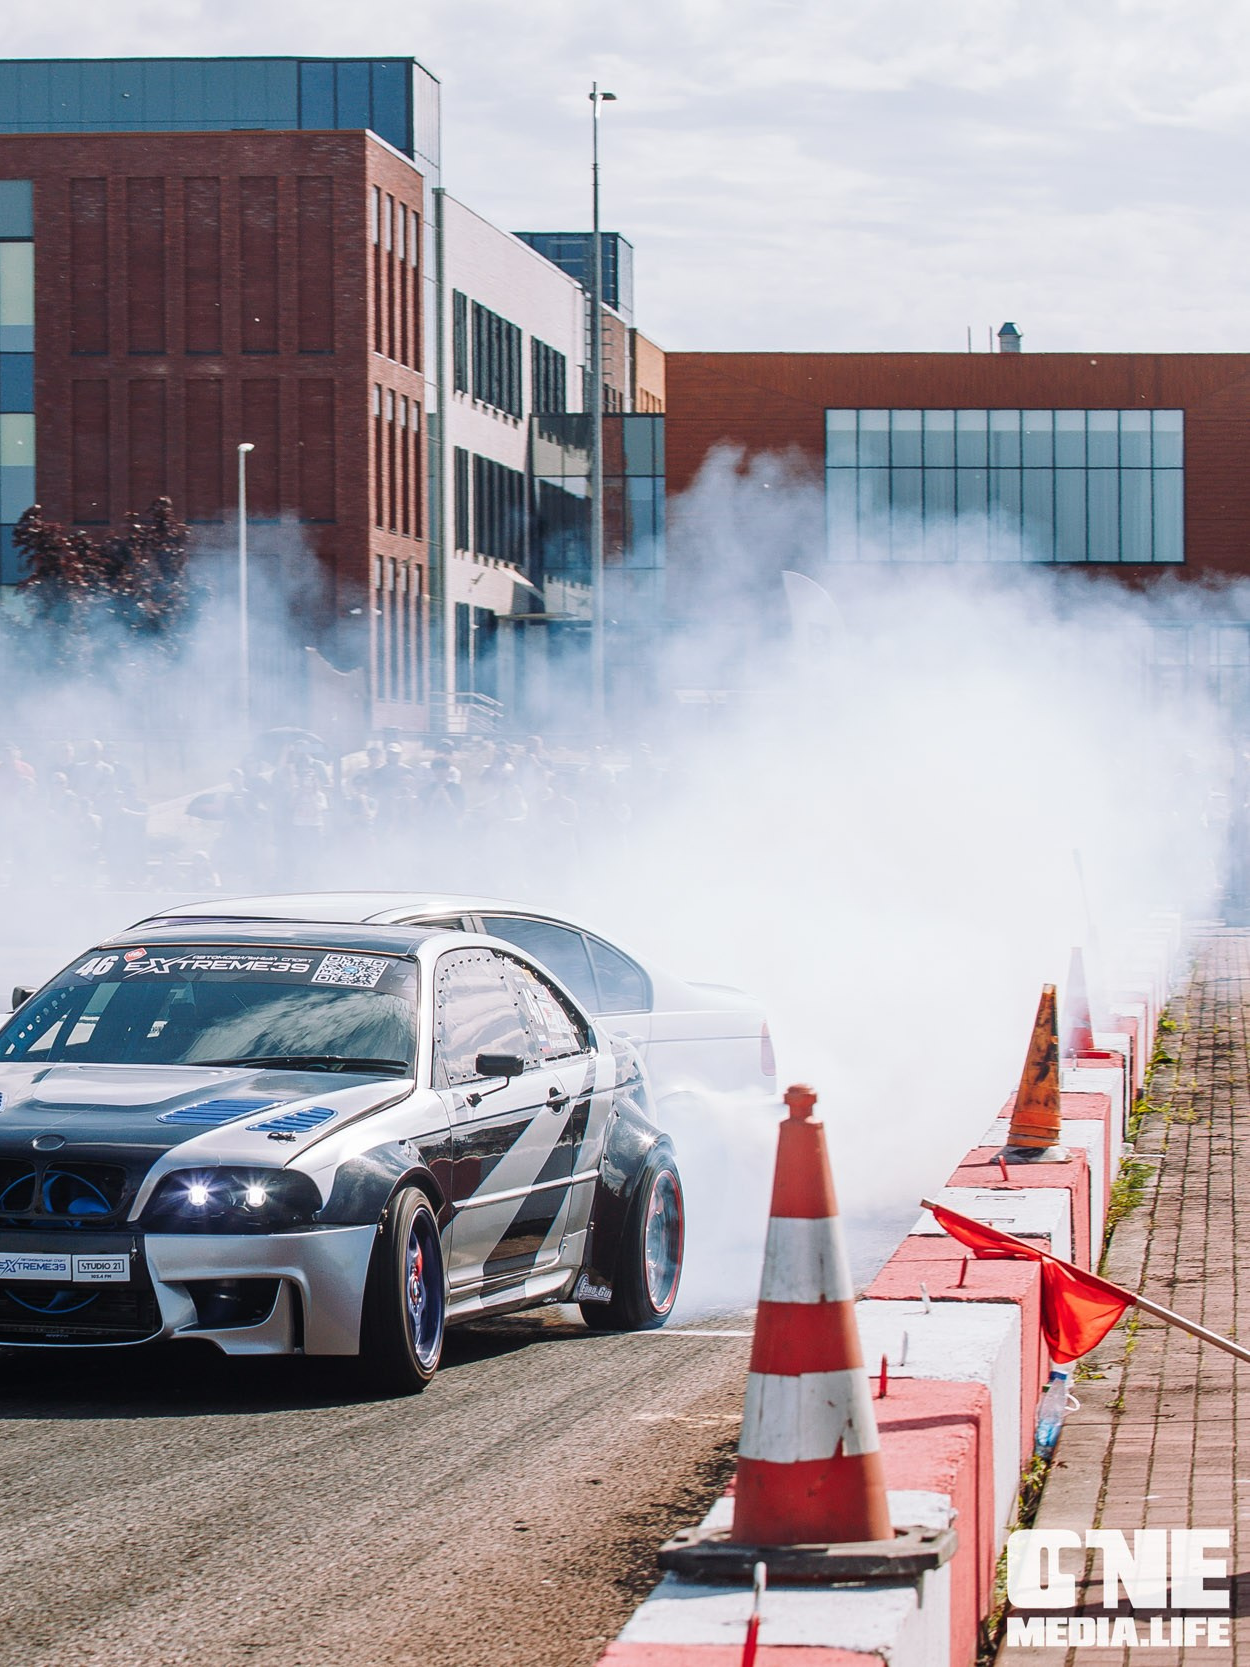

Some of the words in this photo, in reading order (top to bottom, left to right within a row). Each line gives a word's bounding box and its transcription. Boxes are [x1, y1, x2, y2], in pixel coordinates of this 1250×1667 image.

[75, 955, 119, 977] 46
[81, 1262, 111, 1271] STUDIO
[112, 1262, 121, 1270] 21
